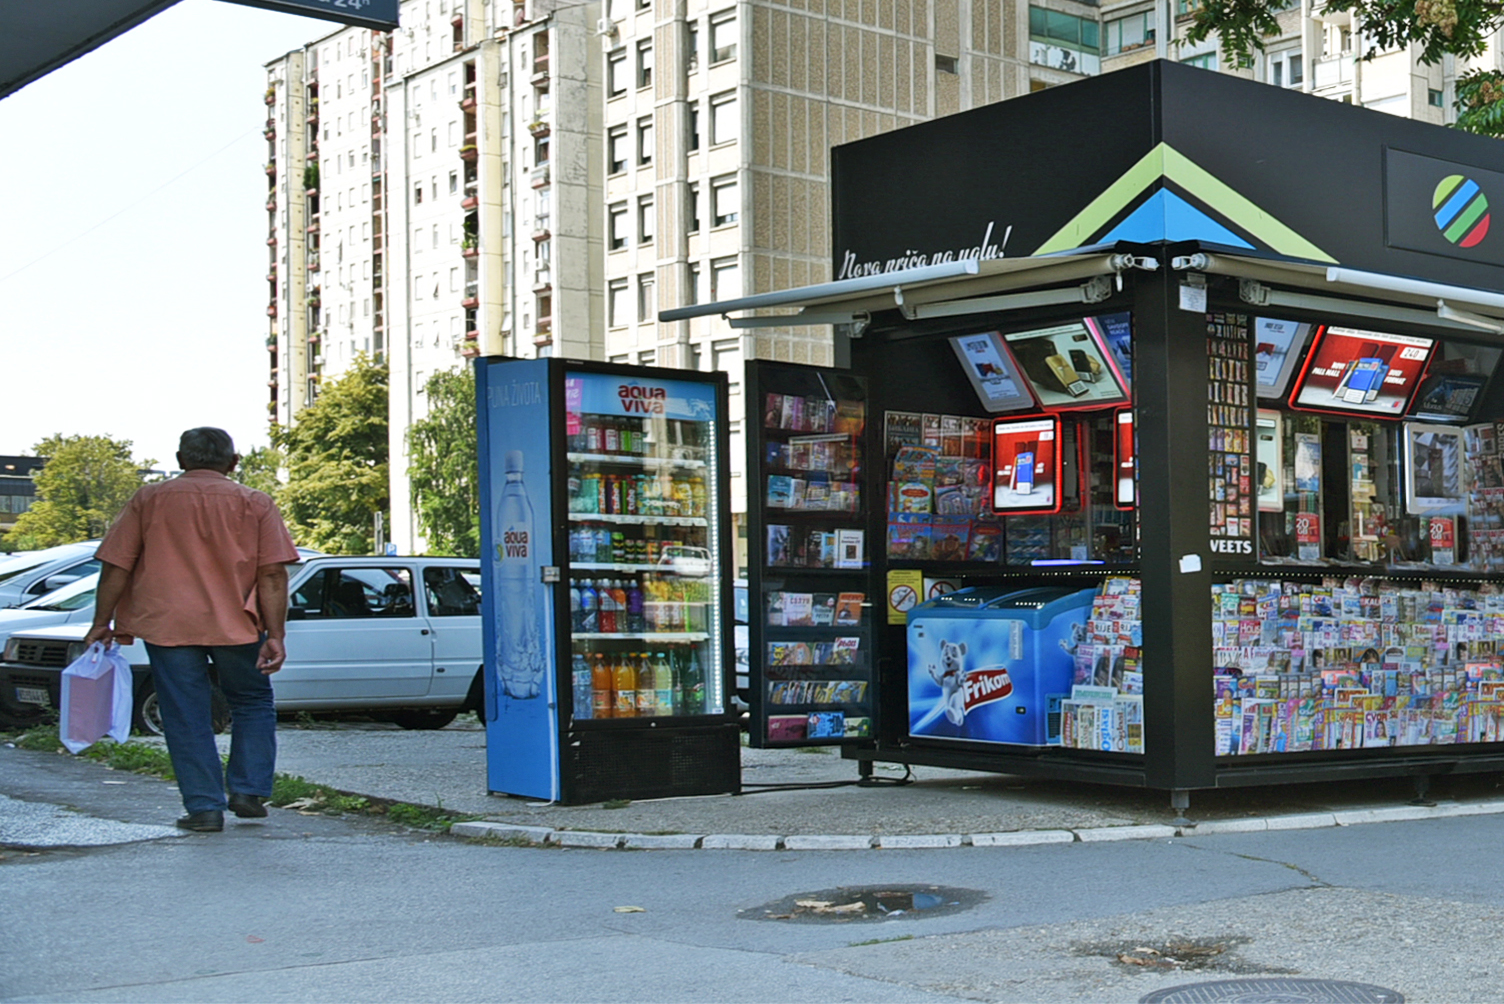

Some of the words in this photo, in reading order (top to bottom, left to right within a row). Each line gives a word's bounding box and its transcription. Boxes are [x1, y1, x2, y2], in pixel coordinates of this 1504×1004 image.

[838, 249, 882, 279] Nova
[621, 400, 664, 414] viva
[1296, 518, 1309, 529] 20
[1430, 523, 1443, 534] 20
[963, 673, 1011, 703] Frikom
